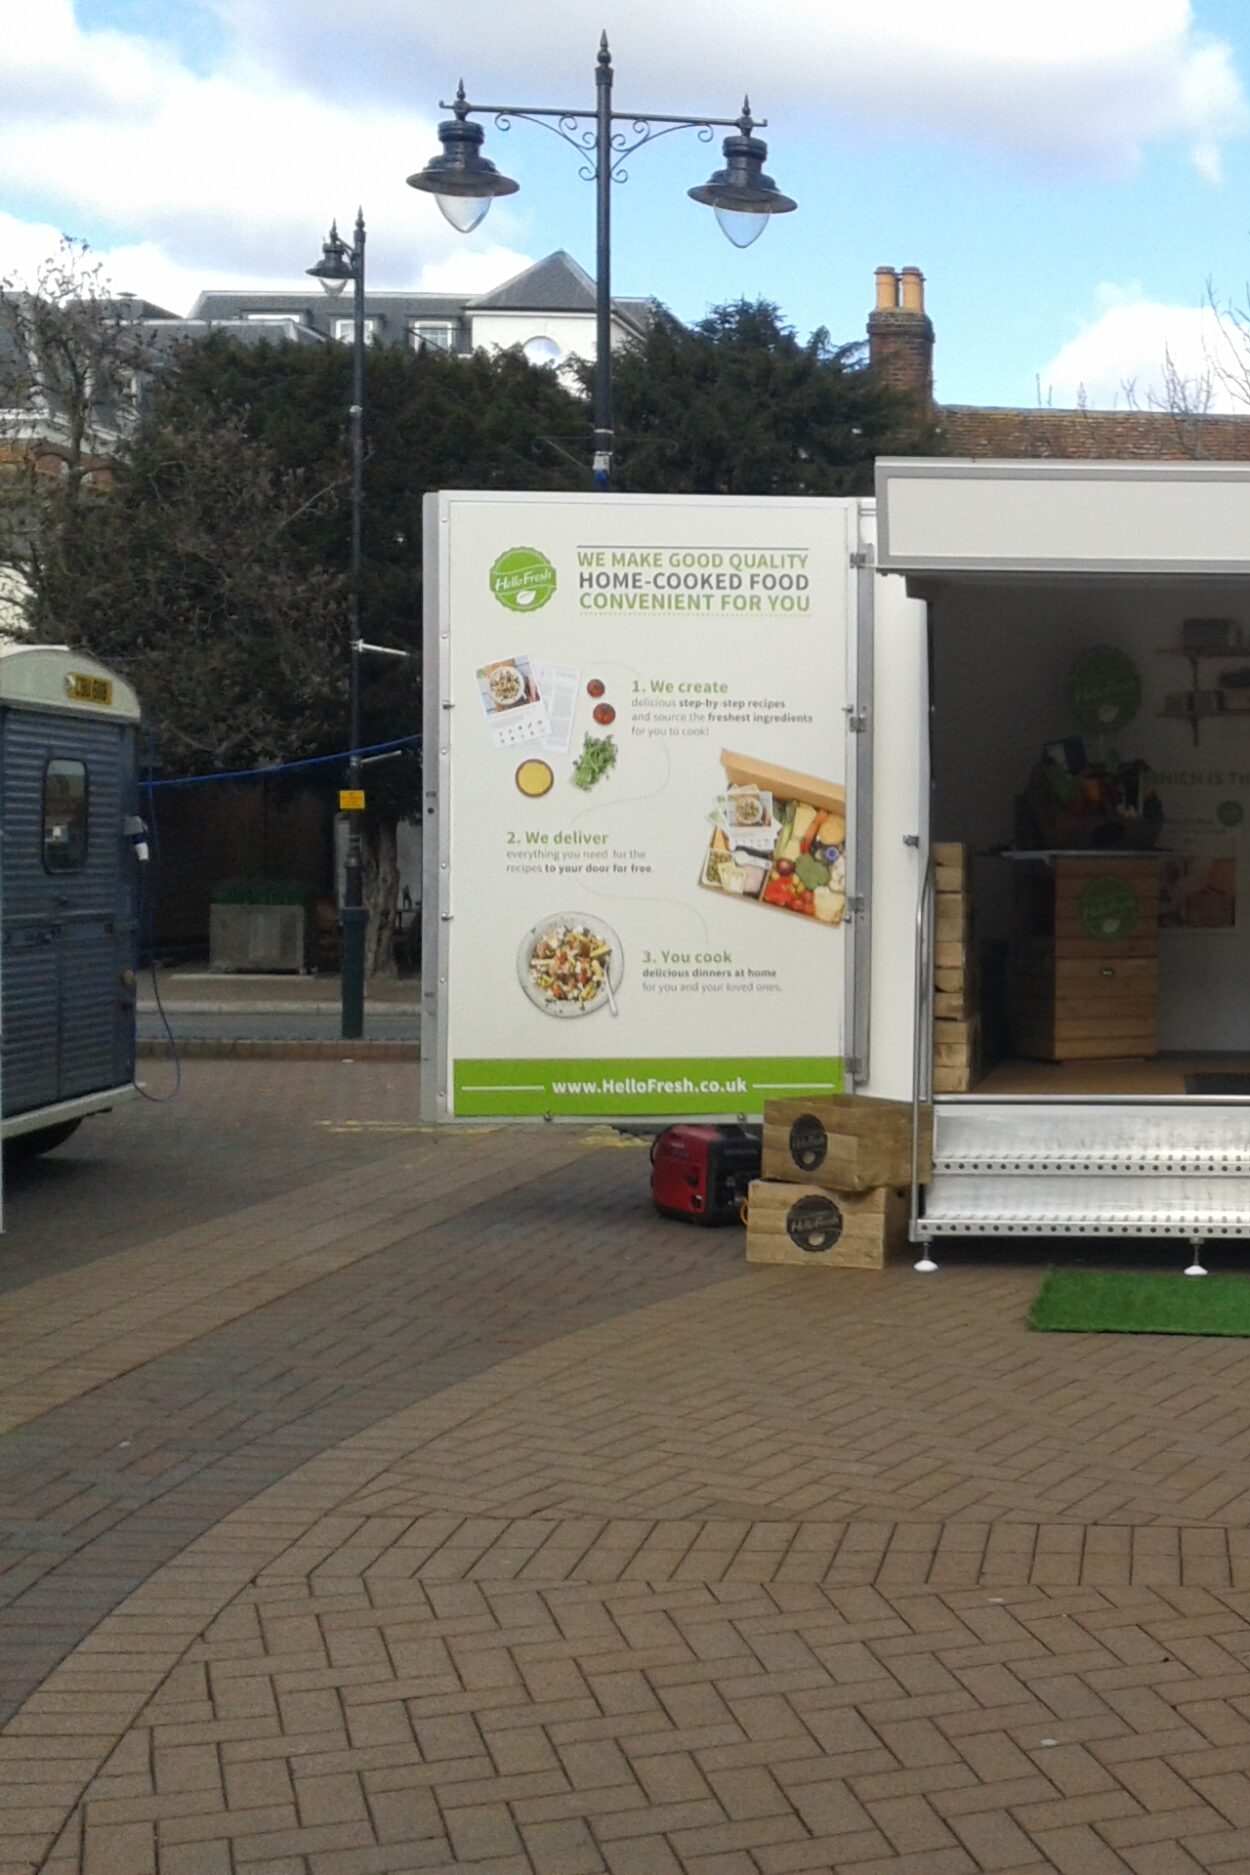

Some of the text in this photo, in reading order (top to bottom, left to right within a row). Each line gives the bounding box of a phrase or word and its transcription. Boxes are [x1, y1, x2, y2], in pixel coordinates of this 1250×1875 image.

[577, 551, 809, 571] WE MAKE GOOD QUALITY
[579, 572, 810, 591] HOME-COOKED FOOD
[579, 594, 811, 612] CONVENIENT FOR YOU
[632, 680, 729, 695] 1. We create
[631, 697, 786, 711] delicious step-by-step recipes
[631, 712, 813, 726] and source the freshest ingredients
[631, 725, 709, 739] for you to cook!
[507, 831, 609, 845] 2. We deliver
[506, 849, 646, 863] everything you need for the
[506, 863, 654, 876] recipes to your door for free.
[643, 950, 732, 963] 3. You cook
[642, 967, 777, 979] delicious dinners at home
[642, 981, 782, 996] for you and your loved ones.
[552, 1077, 748, 1095] www.HelloFresh.co.uk
